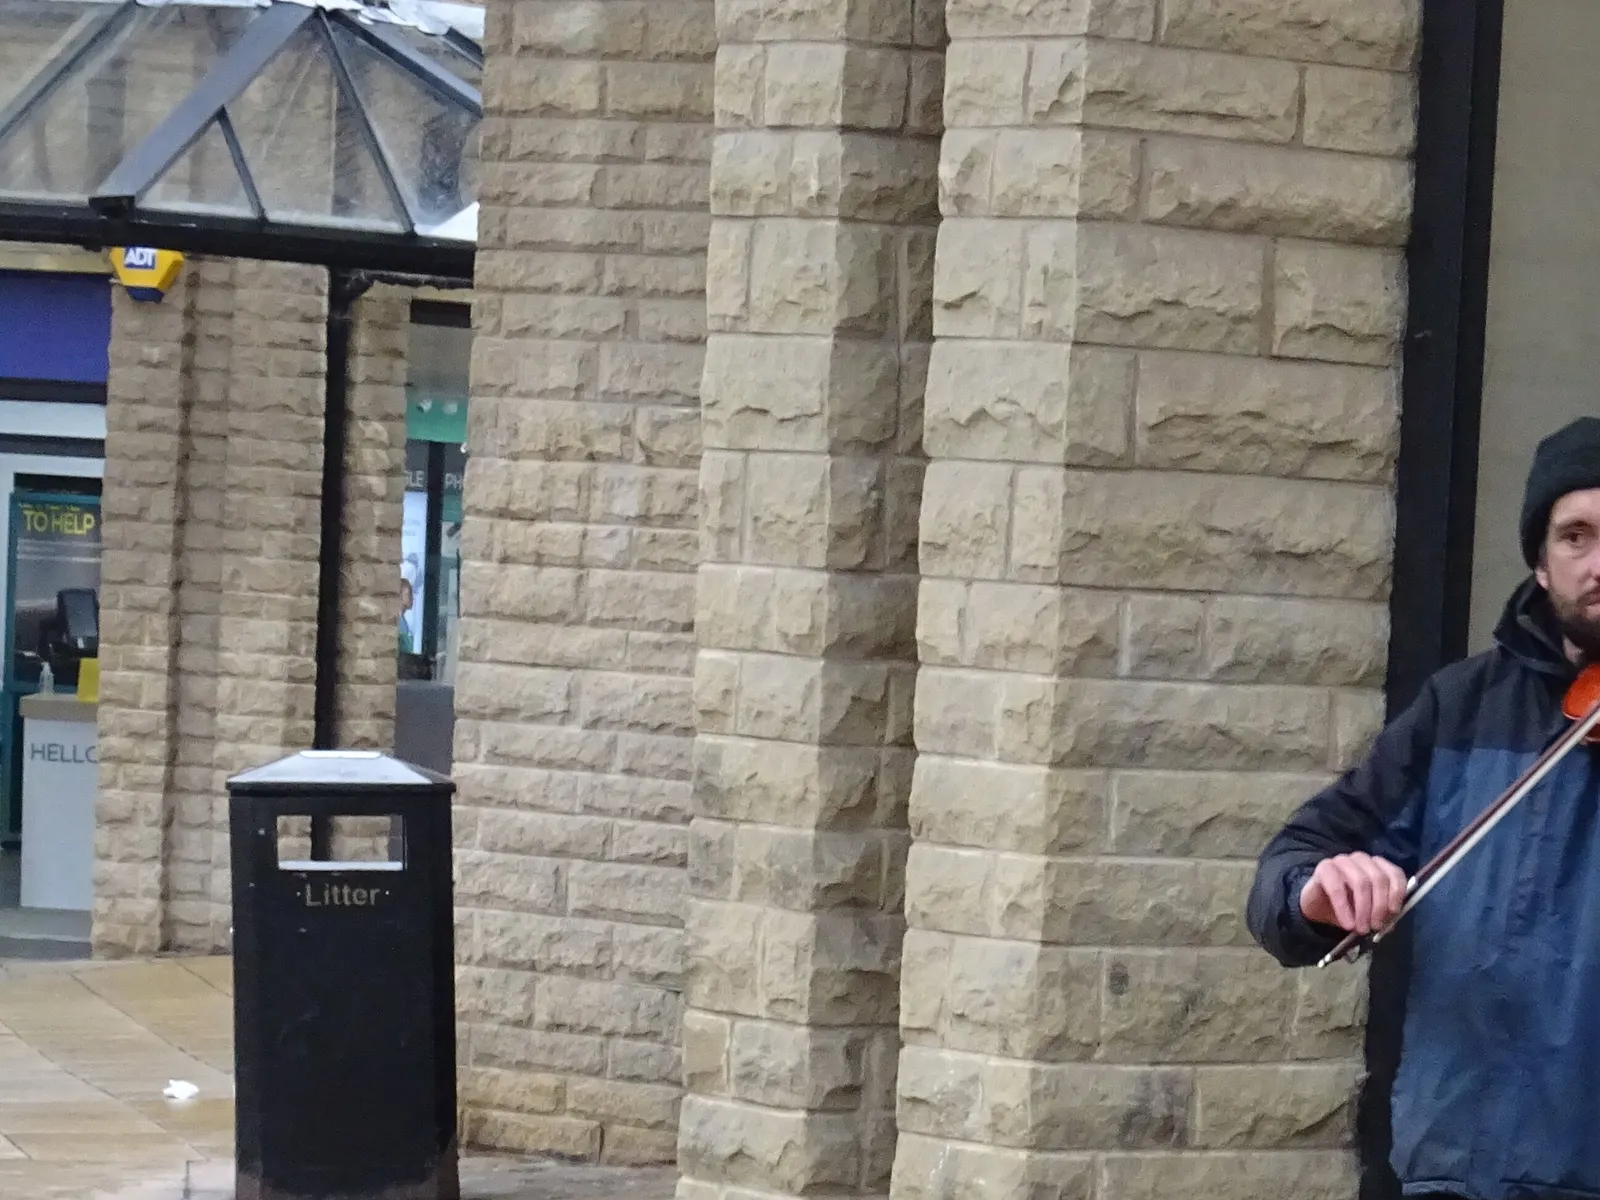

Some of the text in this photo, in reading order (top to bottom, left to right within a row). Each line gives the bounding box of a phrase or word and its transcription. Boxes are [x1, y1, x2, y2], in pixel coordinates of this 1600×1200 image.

[124, 247, 157, 267] ADT
[23, 509, 95, 535] TO HELP
[305, 883, 380, 907] Litter
